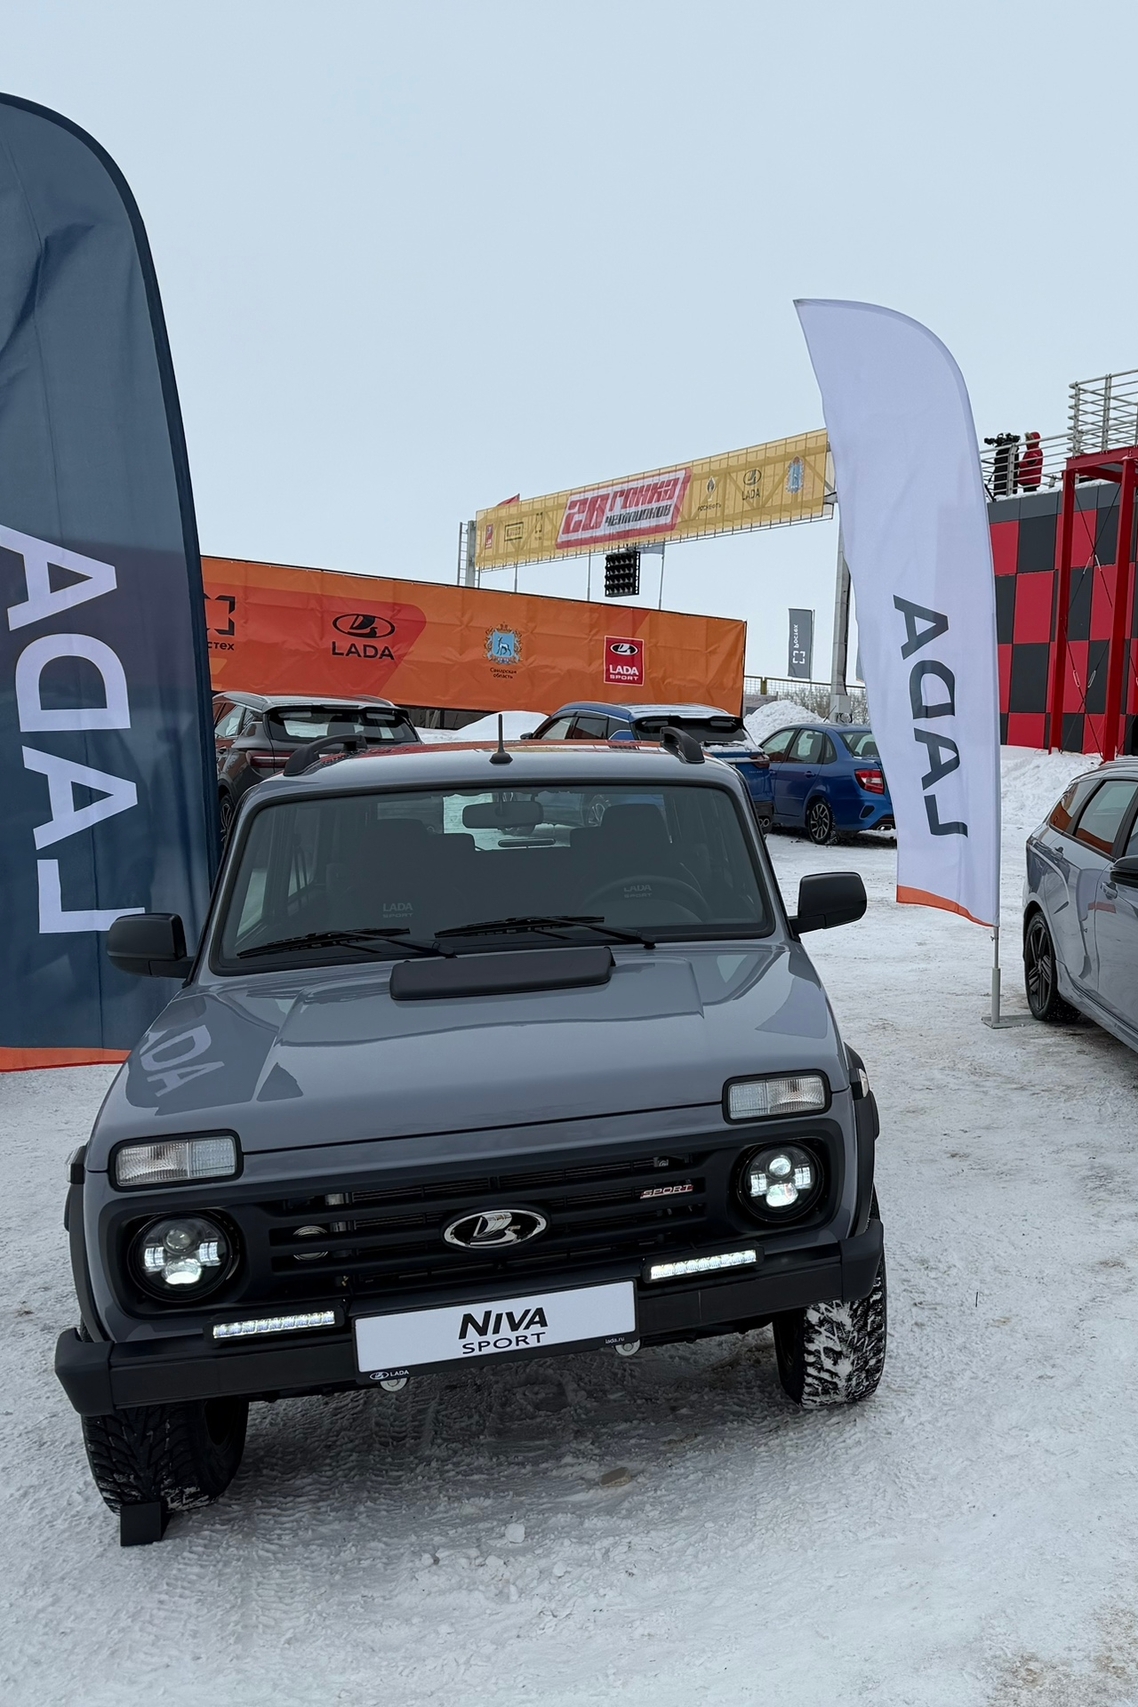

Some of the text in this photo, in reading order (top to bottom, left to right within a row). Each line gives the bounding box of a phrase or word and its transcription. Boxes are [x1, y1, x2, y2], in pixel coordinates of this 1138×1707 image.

[742, 487, 761, 501] LADA
[206, 641, 235, 651] стех
[332, 641, 395, 660] LADA
[609, 664, 639, 675] LADA
[623, 884, 652, 893] LADA
[382, 902, 413, 913] LADA
[640, 1184, 693, 1199] SPORT
[458, 1307, 549, 1340] NIVA
[462, 1332, 546, 1354] SPORT
[605, 1336, 625, 1345] lada.ru
[390, 1369, 409, 1378] LADA
